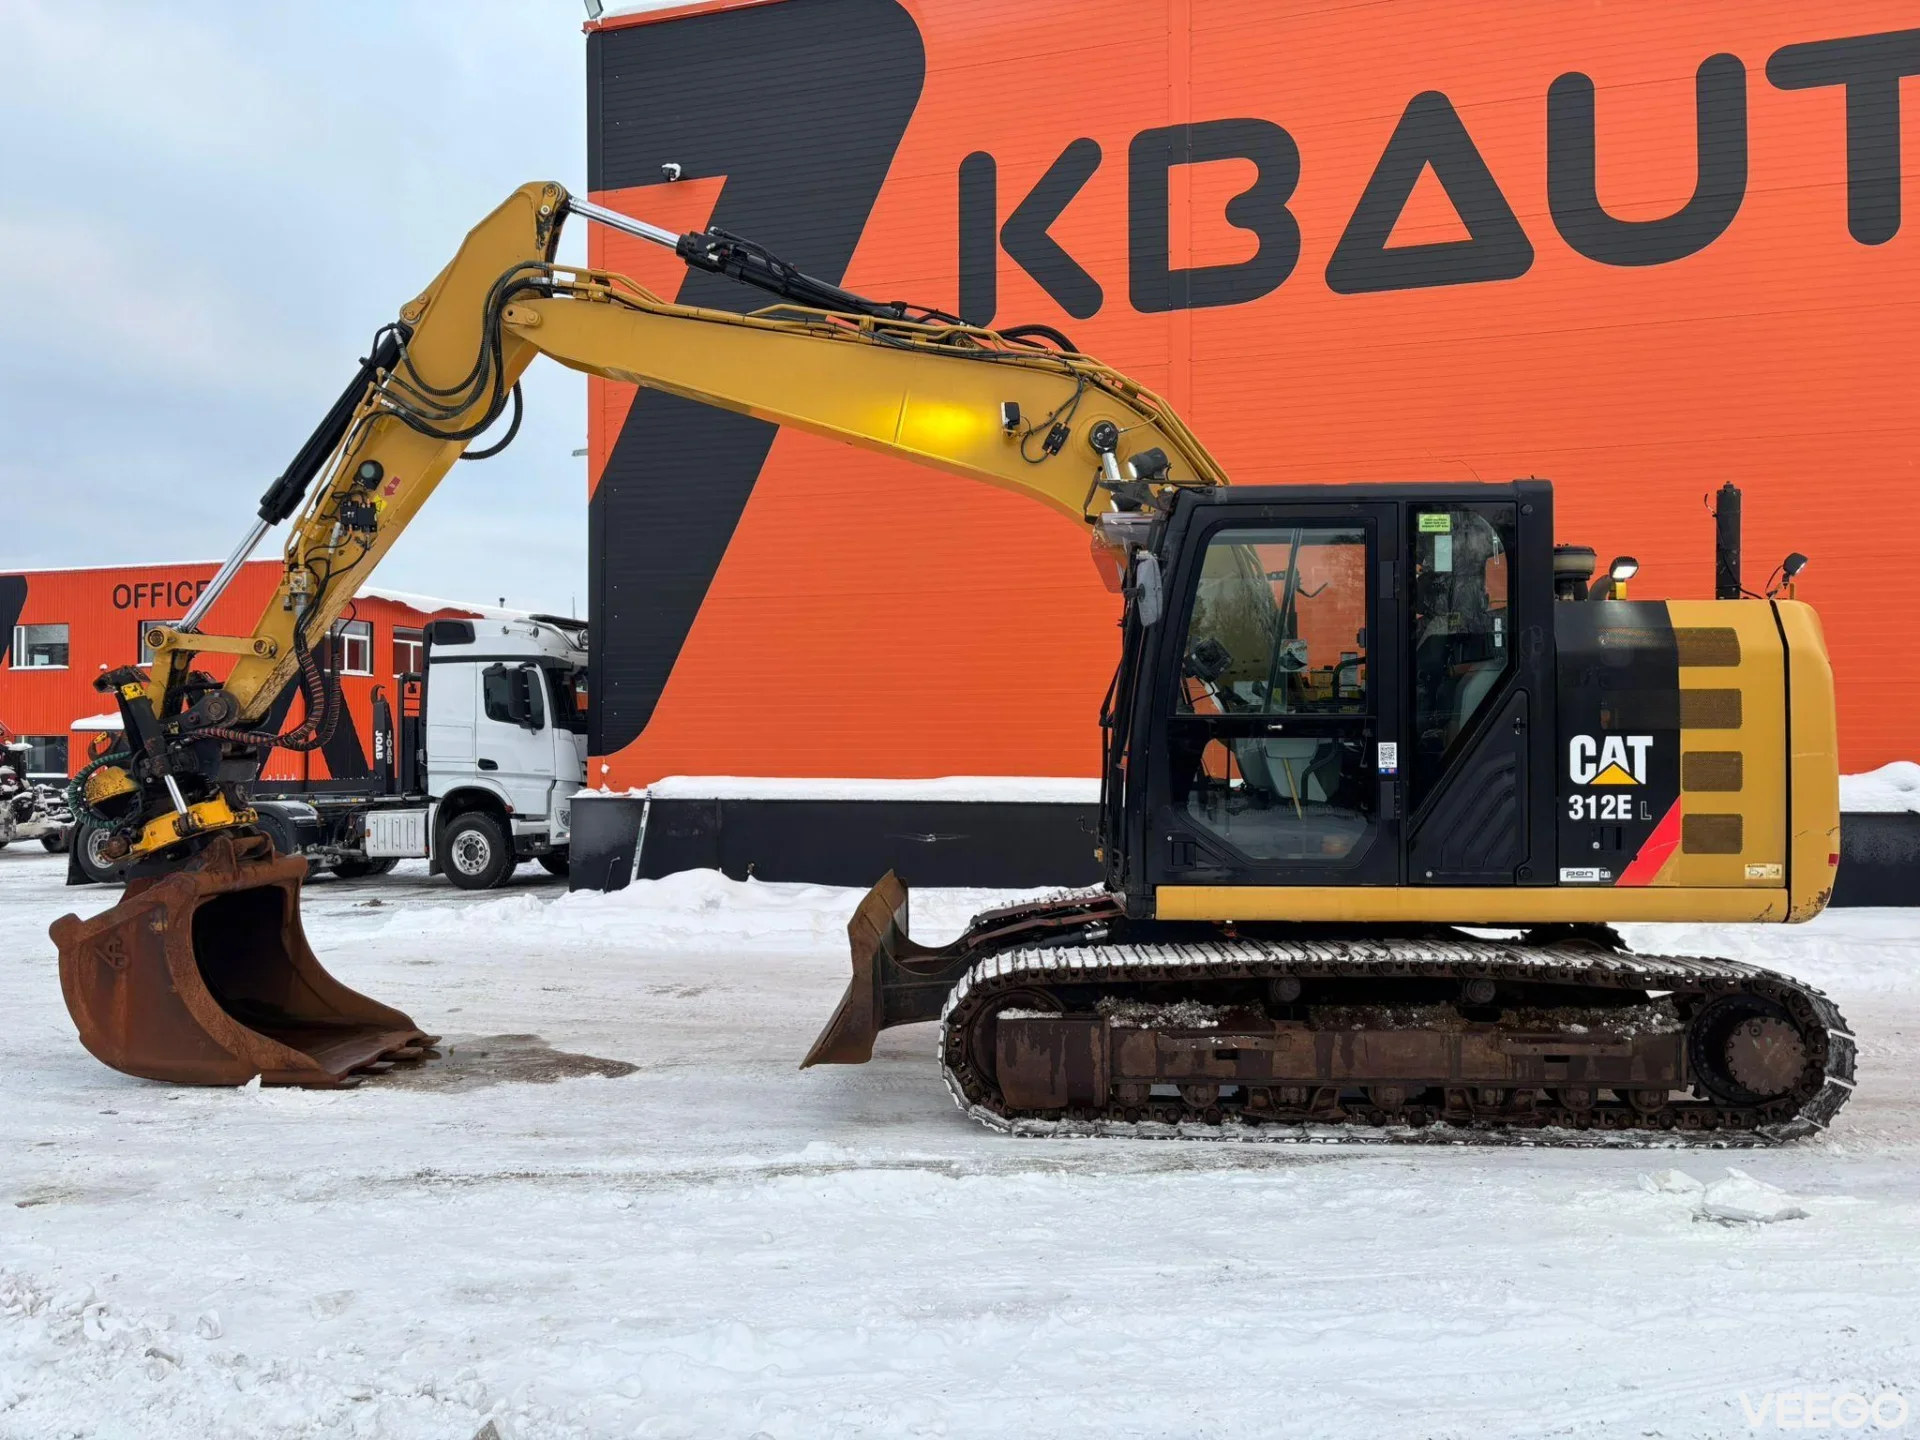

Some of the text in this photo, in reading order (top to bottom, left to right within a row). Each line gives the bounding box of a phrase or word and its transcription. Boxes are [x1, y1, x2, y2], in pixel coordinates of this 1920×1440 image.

[375, 730, 384, 760] JOAB
[1569, 734, 1654, 785] CAT
[1568, 794, 1652, 820] 312E L
